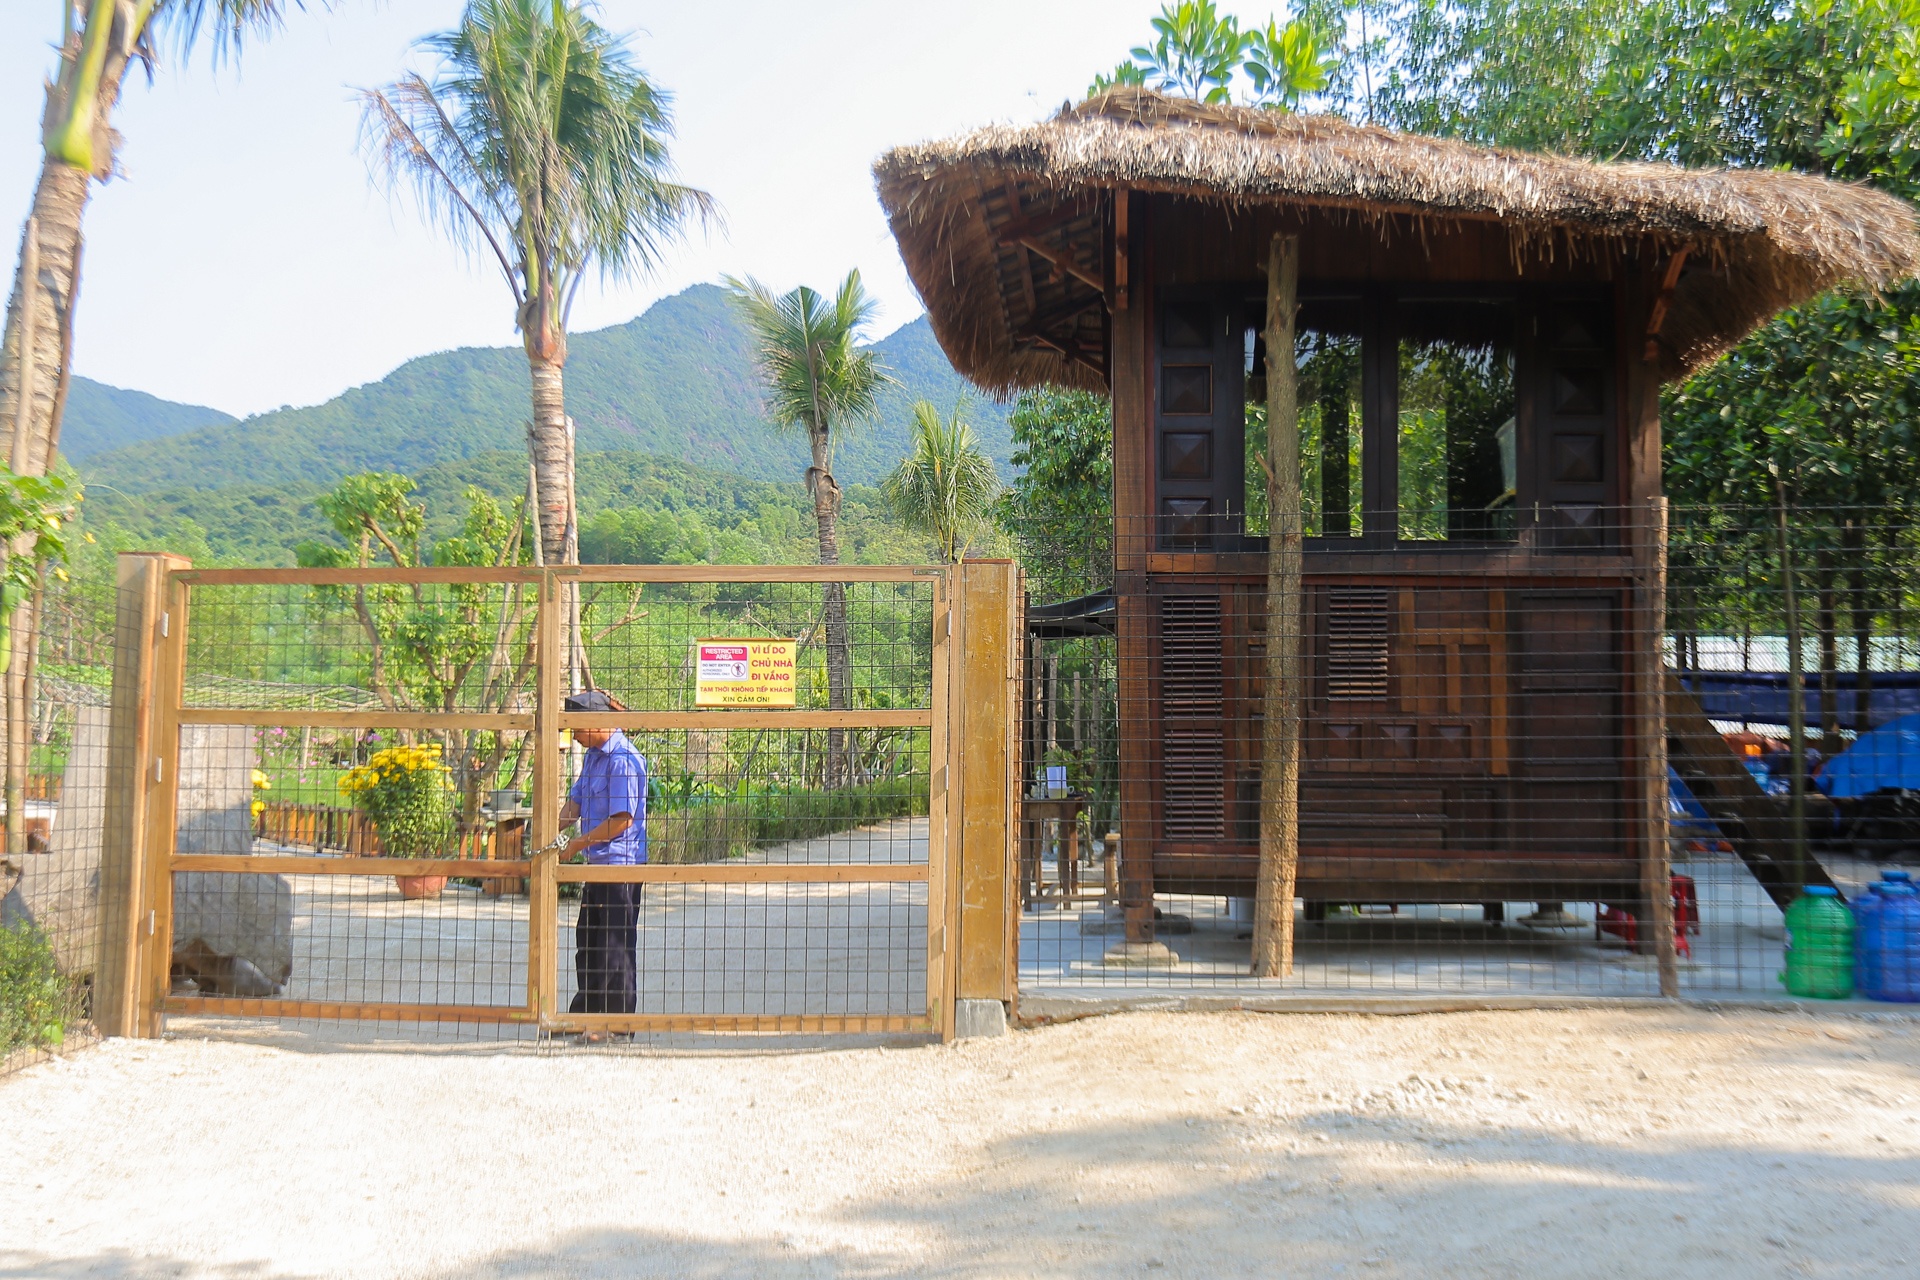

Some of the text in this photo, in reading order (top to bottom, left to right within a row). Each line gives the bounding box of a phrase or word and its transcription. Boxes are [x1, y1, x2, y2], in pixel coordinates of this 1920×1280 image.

[751, 644, 786, 654] VÌ LÍ DO
[751, 657, 793, 667] CHỦ NHÀ
[751, 670, 790, 681] ĐI VẮNG
[756, 685, 769, 693] TIẾP
[737, 694, 755, 703] CẢM
[756, 695, 770, 703] ƠN!
